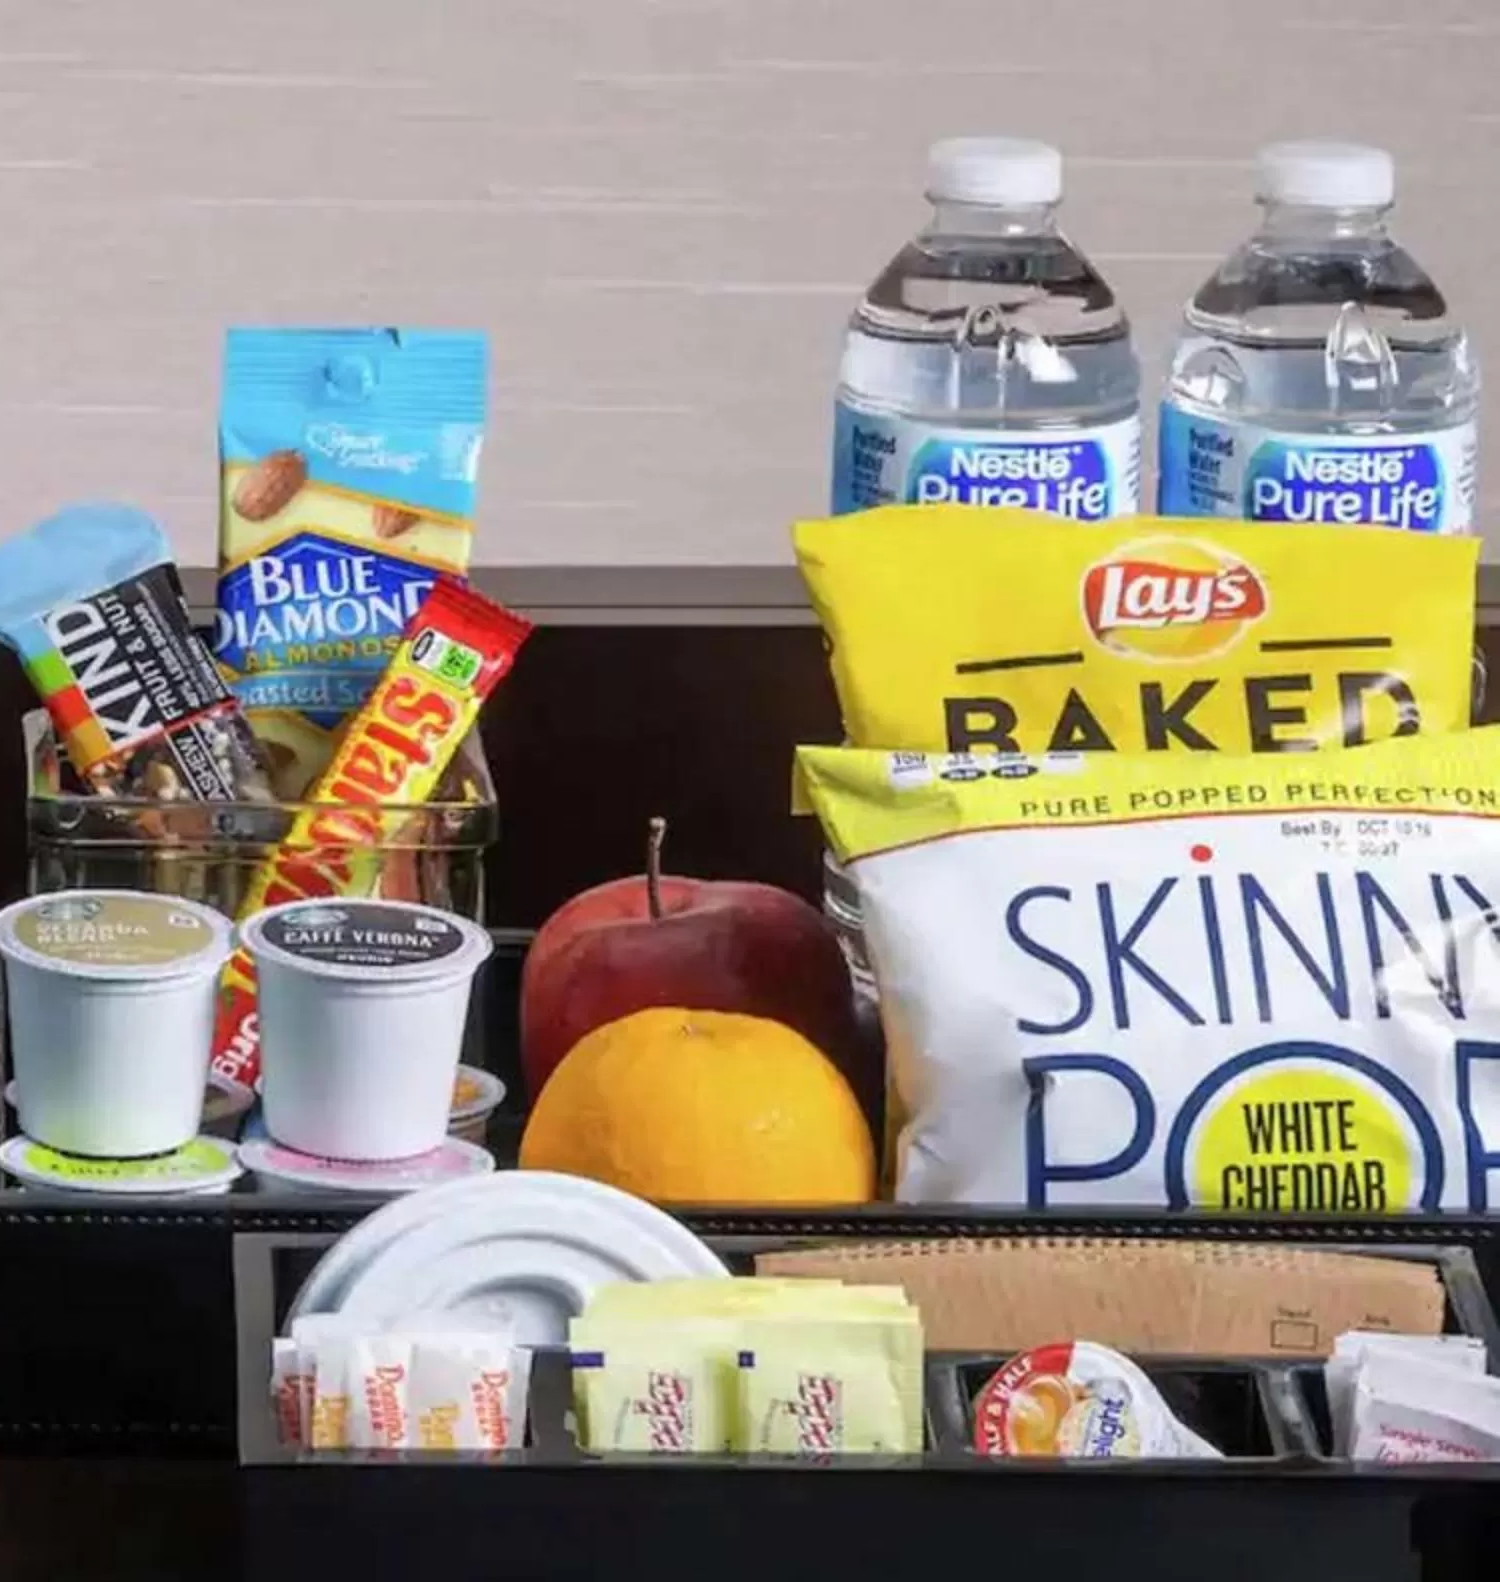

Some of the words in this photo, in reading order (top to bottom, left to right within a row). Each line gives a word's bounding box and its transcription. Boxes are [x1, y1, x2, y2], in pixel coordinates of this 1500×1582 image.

[918, 474, 1031, 507] Pure
[1037, 476, 1109, 520] Life
[1254, 476, 1362, 523] Pure
[1371, 481, 1438, 530] Life
[249, 555, 382, 607] BLUE
[1099, 562, 1247, 631] Lay's
[98, 592, 137, 636] NUT
[126, 635, 148, 654] &
[243, 635, 403, 672] ALMONDS
[48, 601, 164, 750] KIND
[135, 660, 184, 720] FRUIT
[942, 671, 1420, 754] BAKED
[176, 735, 228, 801] ASHEW
[1020, 795, 1112, 818] PURE
[1129, 785, 1268, 810] POPPED
[1280, 819, 1317, 837] Best
[1320, 819, 1342, 838] By
[1242, 1100, 1359, 1156] WHITE
[1221, 1159, 1388, 1213] CHEDDAR
[1092, 1397, 1126, 1458] elight
